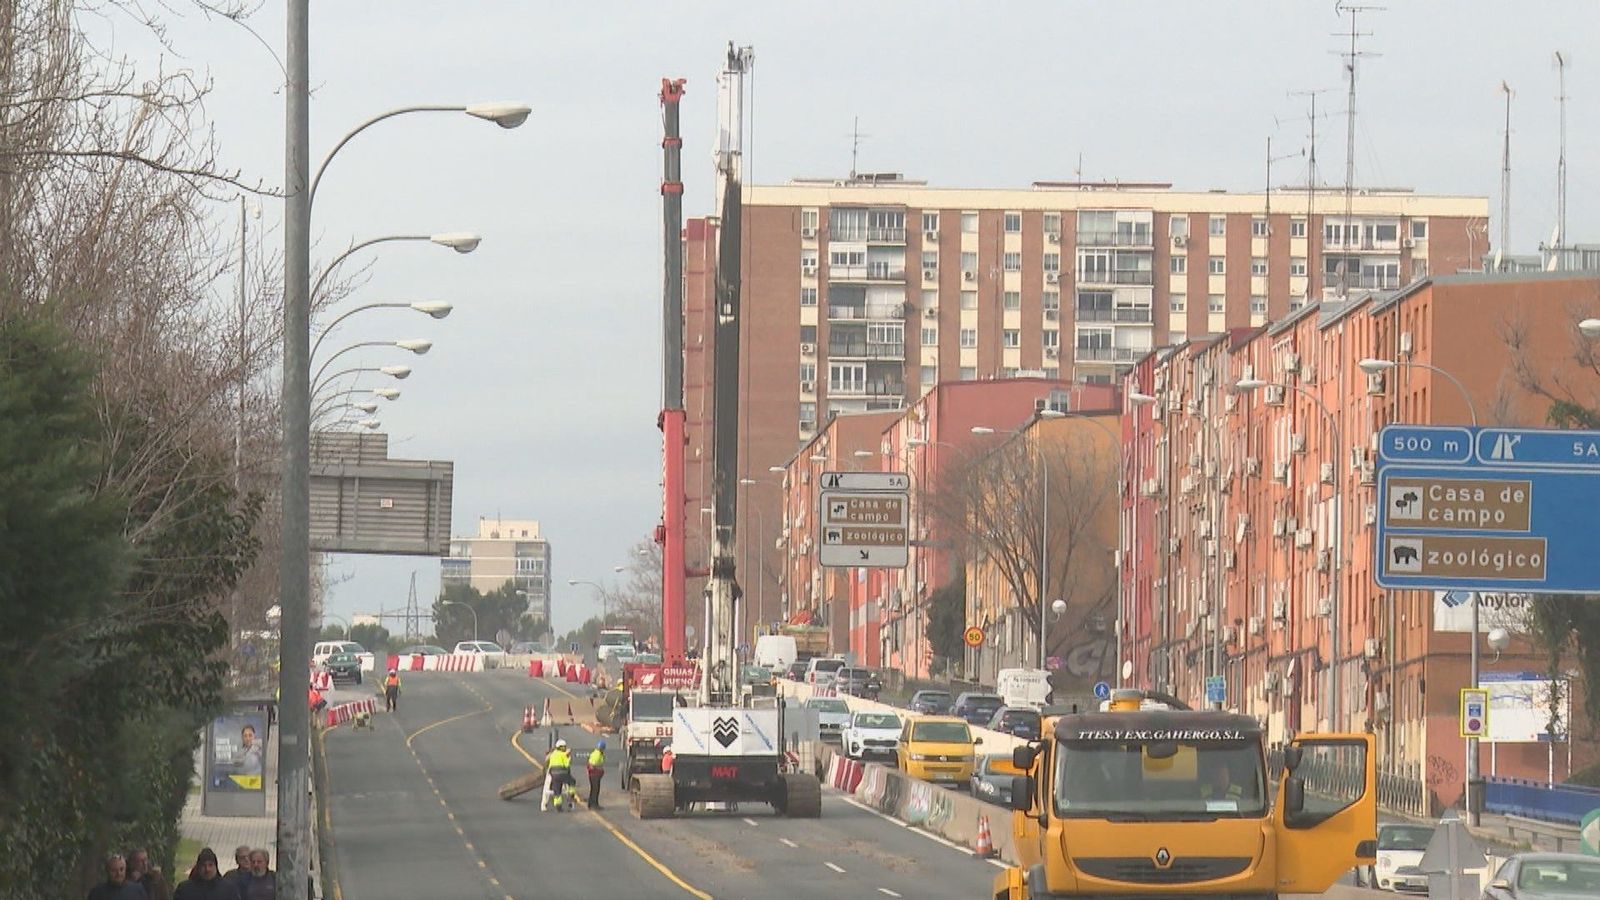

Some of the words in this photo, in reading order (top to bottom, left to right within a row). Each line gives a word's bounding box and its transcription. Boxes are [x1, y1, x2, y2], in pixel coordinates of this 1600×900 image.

[1394, 437, 1431, 452] 500
[1444, 440, 1459, 453] m
[1573, 442, 1599, 457] 5A
[889, 478, 903, 487] 5A
[1429, 485, 1485, 502] Casa
[1500, 486, 1524, 503] de
[851, 499, 879, 509] Casa
[886, 500, 898, 509] de
[850, 513, 889, 523] campo
[1428, 507, 1505, 527] campo
[846, 530, 903, 543] zoológico
[1428, 548, 1541, 571] zoológico
[969, 632, 981, 641] 50
[663, 668, 693, 676] GRUAS
